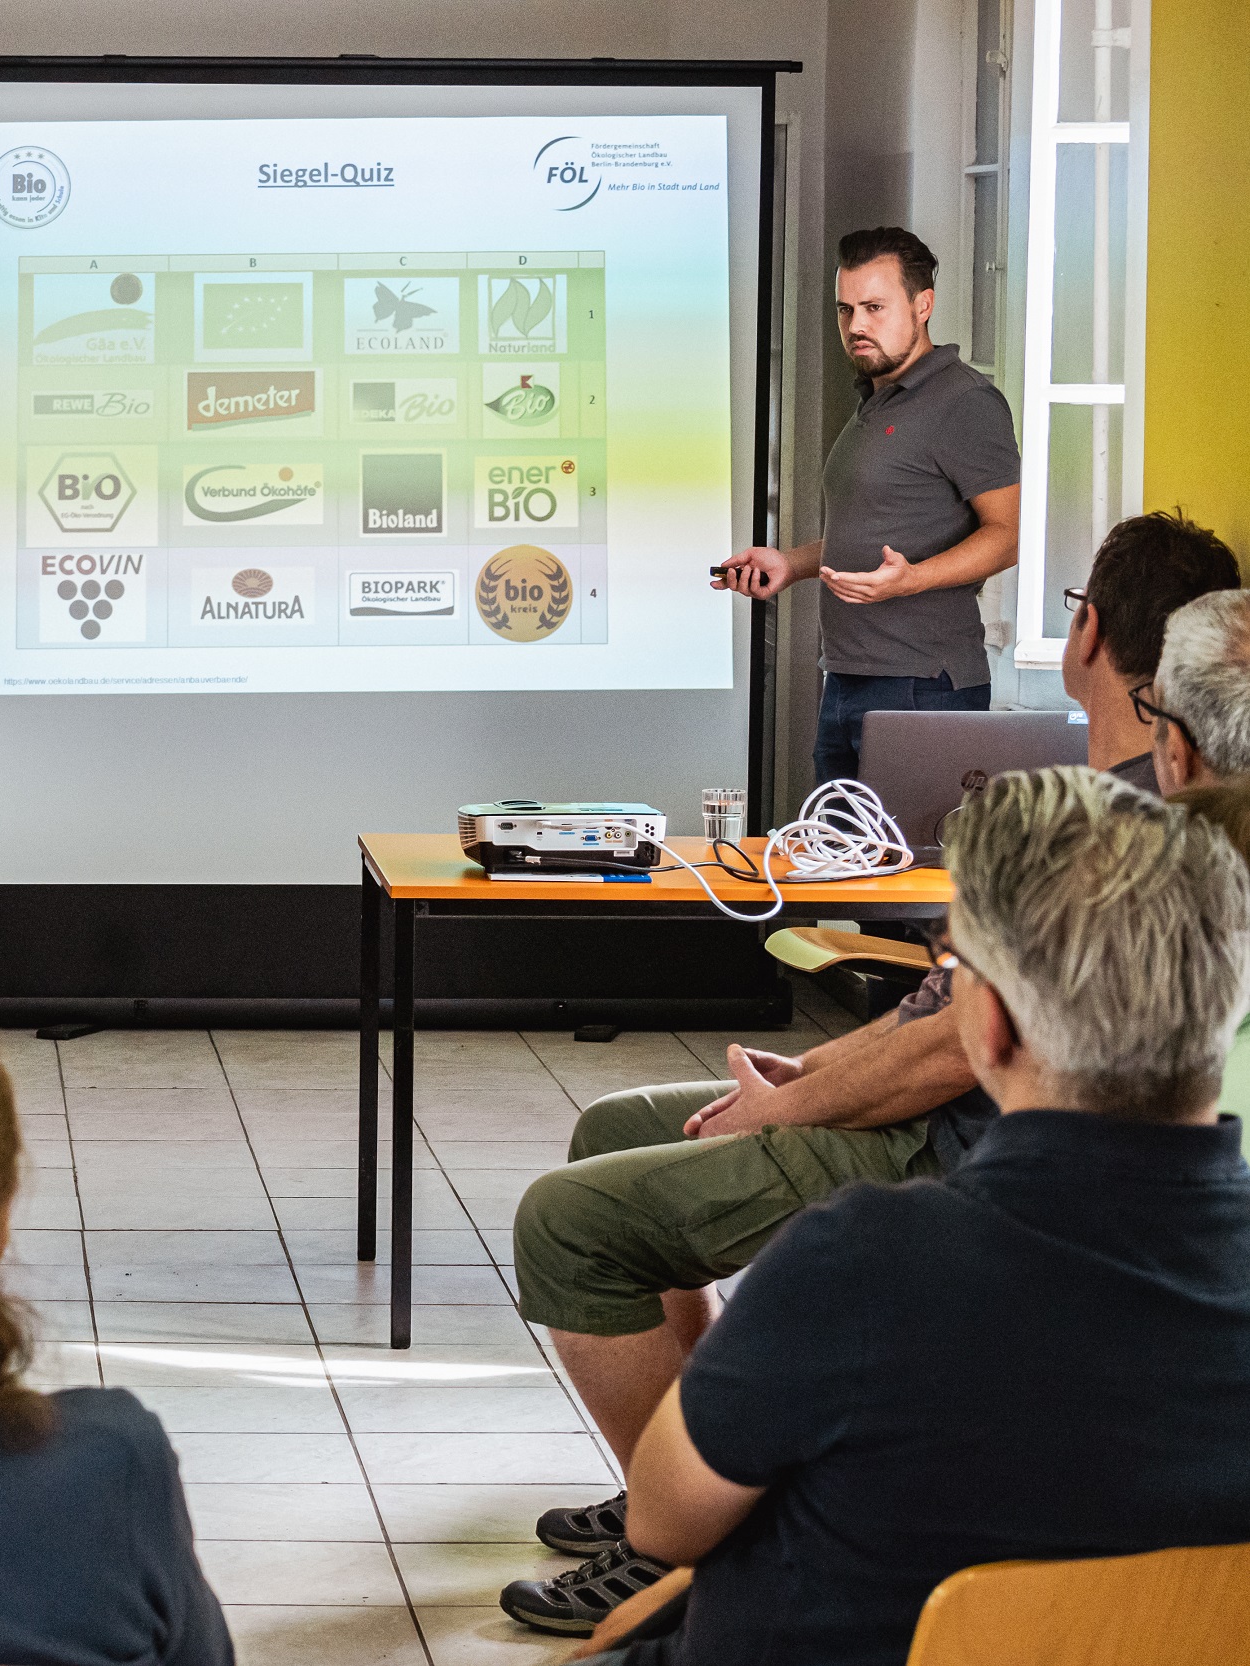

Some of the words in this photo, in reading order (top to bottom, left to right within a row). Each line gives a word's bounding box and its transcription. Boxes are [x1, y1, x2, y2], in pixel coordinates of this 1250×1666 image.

[591, 142, 660, 151] Fördergemeinschaft
[591, 151, 637, 160] Ökologischer
[591, 160, 659, 168] Berlin-Brandenburg
[258, 161, 395, 188] Siegel-Quiz
[546, 161, 589, 184] FÖL
[12, 172, 47, 194] Bio
[607, 183, 630, 191] Mehr
[631, 183, 646, 191] Bio
[647, 183, 655, 191] in
[657, 183, 680, 191] Stadt
[681, 183, 697, 191] und
[699, 183, 720, 191] Land
[89, 259, 98, 270] A
[249, 257, 257, 268] B
[399, 256, 407, 267] C
[518, 255, 527, 266] D
[588, 310, 595, 320] 1
[356, 336, 445, 350] ECOLAND
[488, 341, 556, 354] Naturland
[52, 399, 93, 411] REWE
[96, 392, 150, 418] Bio
[197, 384, 301, 418] demeter
[399, 392, 456, 422] Bio
[500, 388, 552, 421] Bio
[589, 395, 596, 405] 2
[487, 464, 557, 485] ener
[202, 484, 257, 498] Verbund
[260, 481, 317, 498] Ökohöfe
[589, 486, 596, 497] 3
[366, 508, 438, 530] Bioland
[41, 554, 144, 576] ECOVIN
[361, 580, 441, 594] BIOPARK
[504, 578, 544, 602] bio
[589, 588, 597, 599] 4
[361, 595, 409, 603] Ökologischer
[510, 604, 539, 614] kreis
